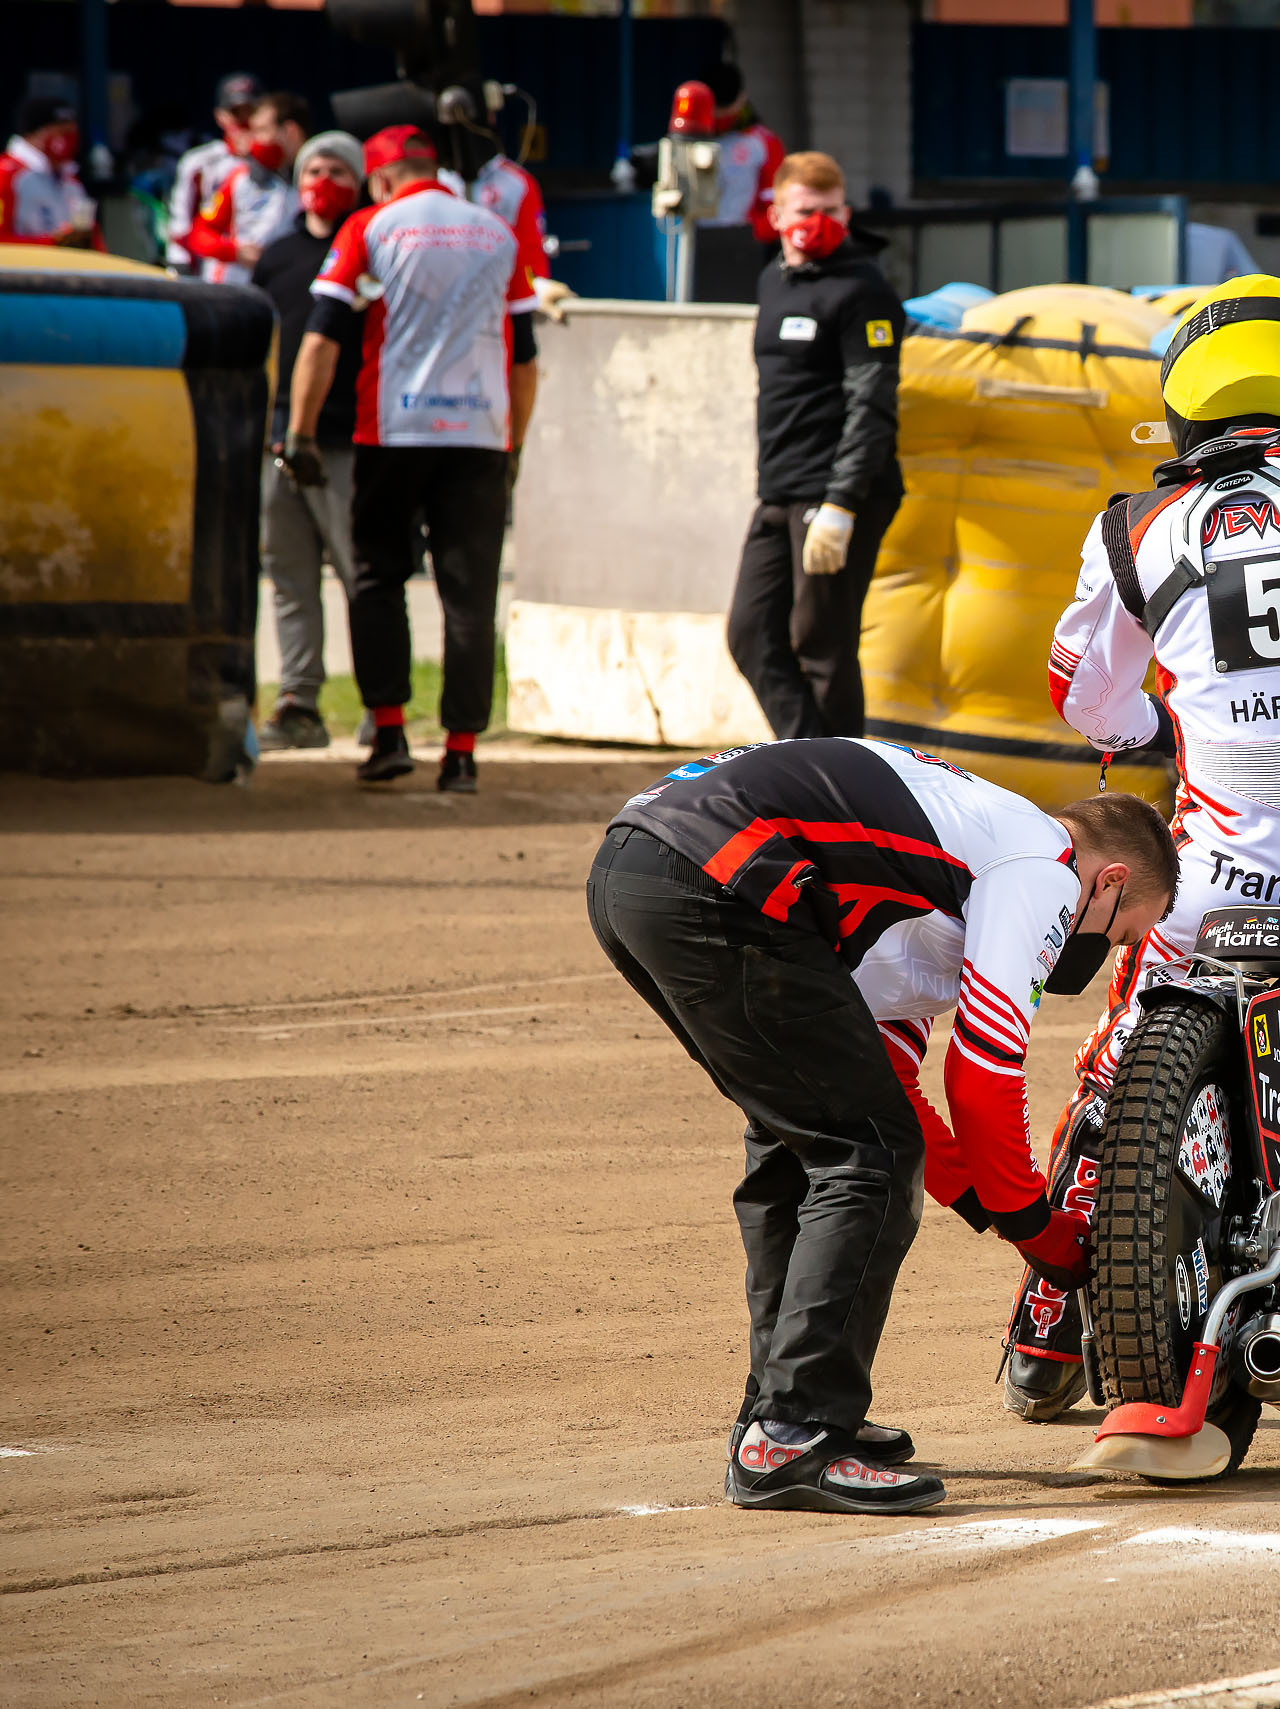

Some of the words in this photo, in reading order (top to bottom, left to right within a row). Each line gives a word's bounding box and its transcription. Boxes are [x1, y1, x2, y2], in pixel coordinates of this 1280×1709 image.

[1203, 441, 1236, 454] ORTEMA
[1216, 474, 1252, 490] ORTEMA
[1206, 921, 1235, 939] Michi
[1243, 923, 1280, 931] RACING
[1193, 1248, 1208, 1314] ZUPIN
[1038, 1308, 1051, 1337] FREY
